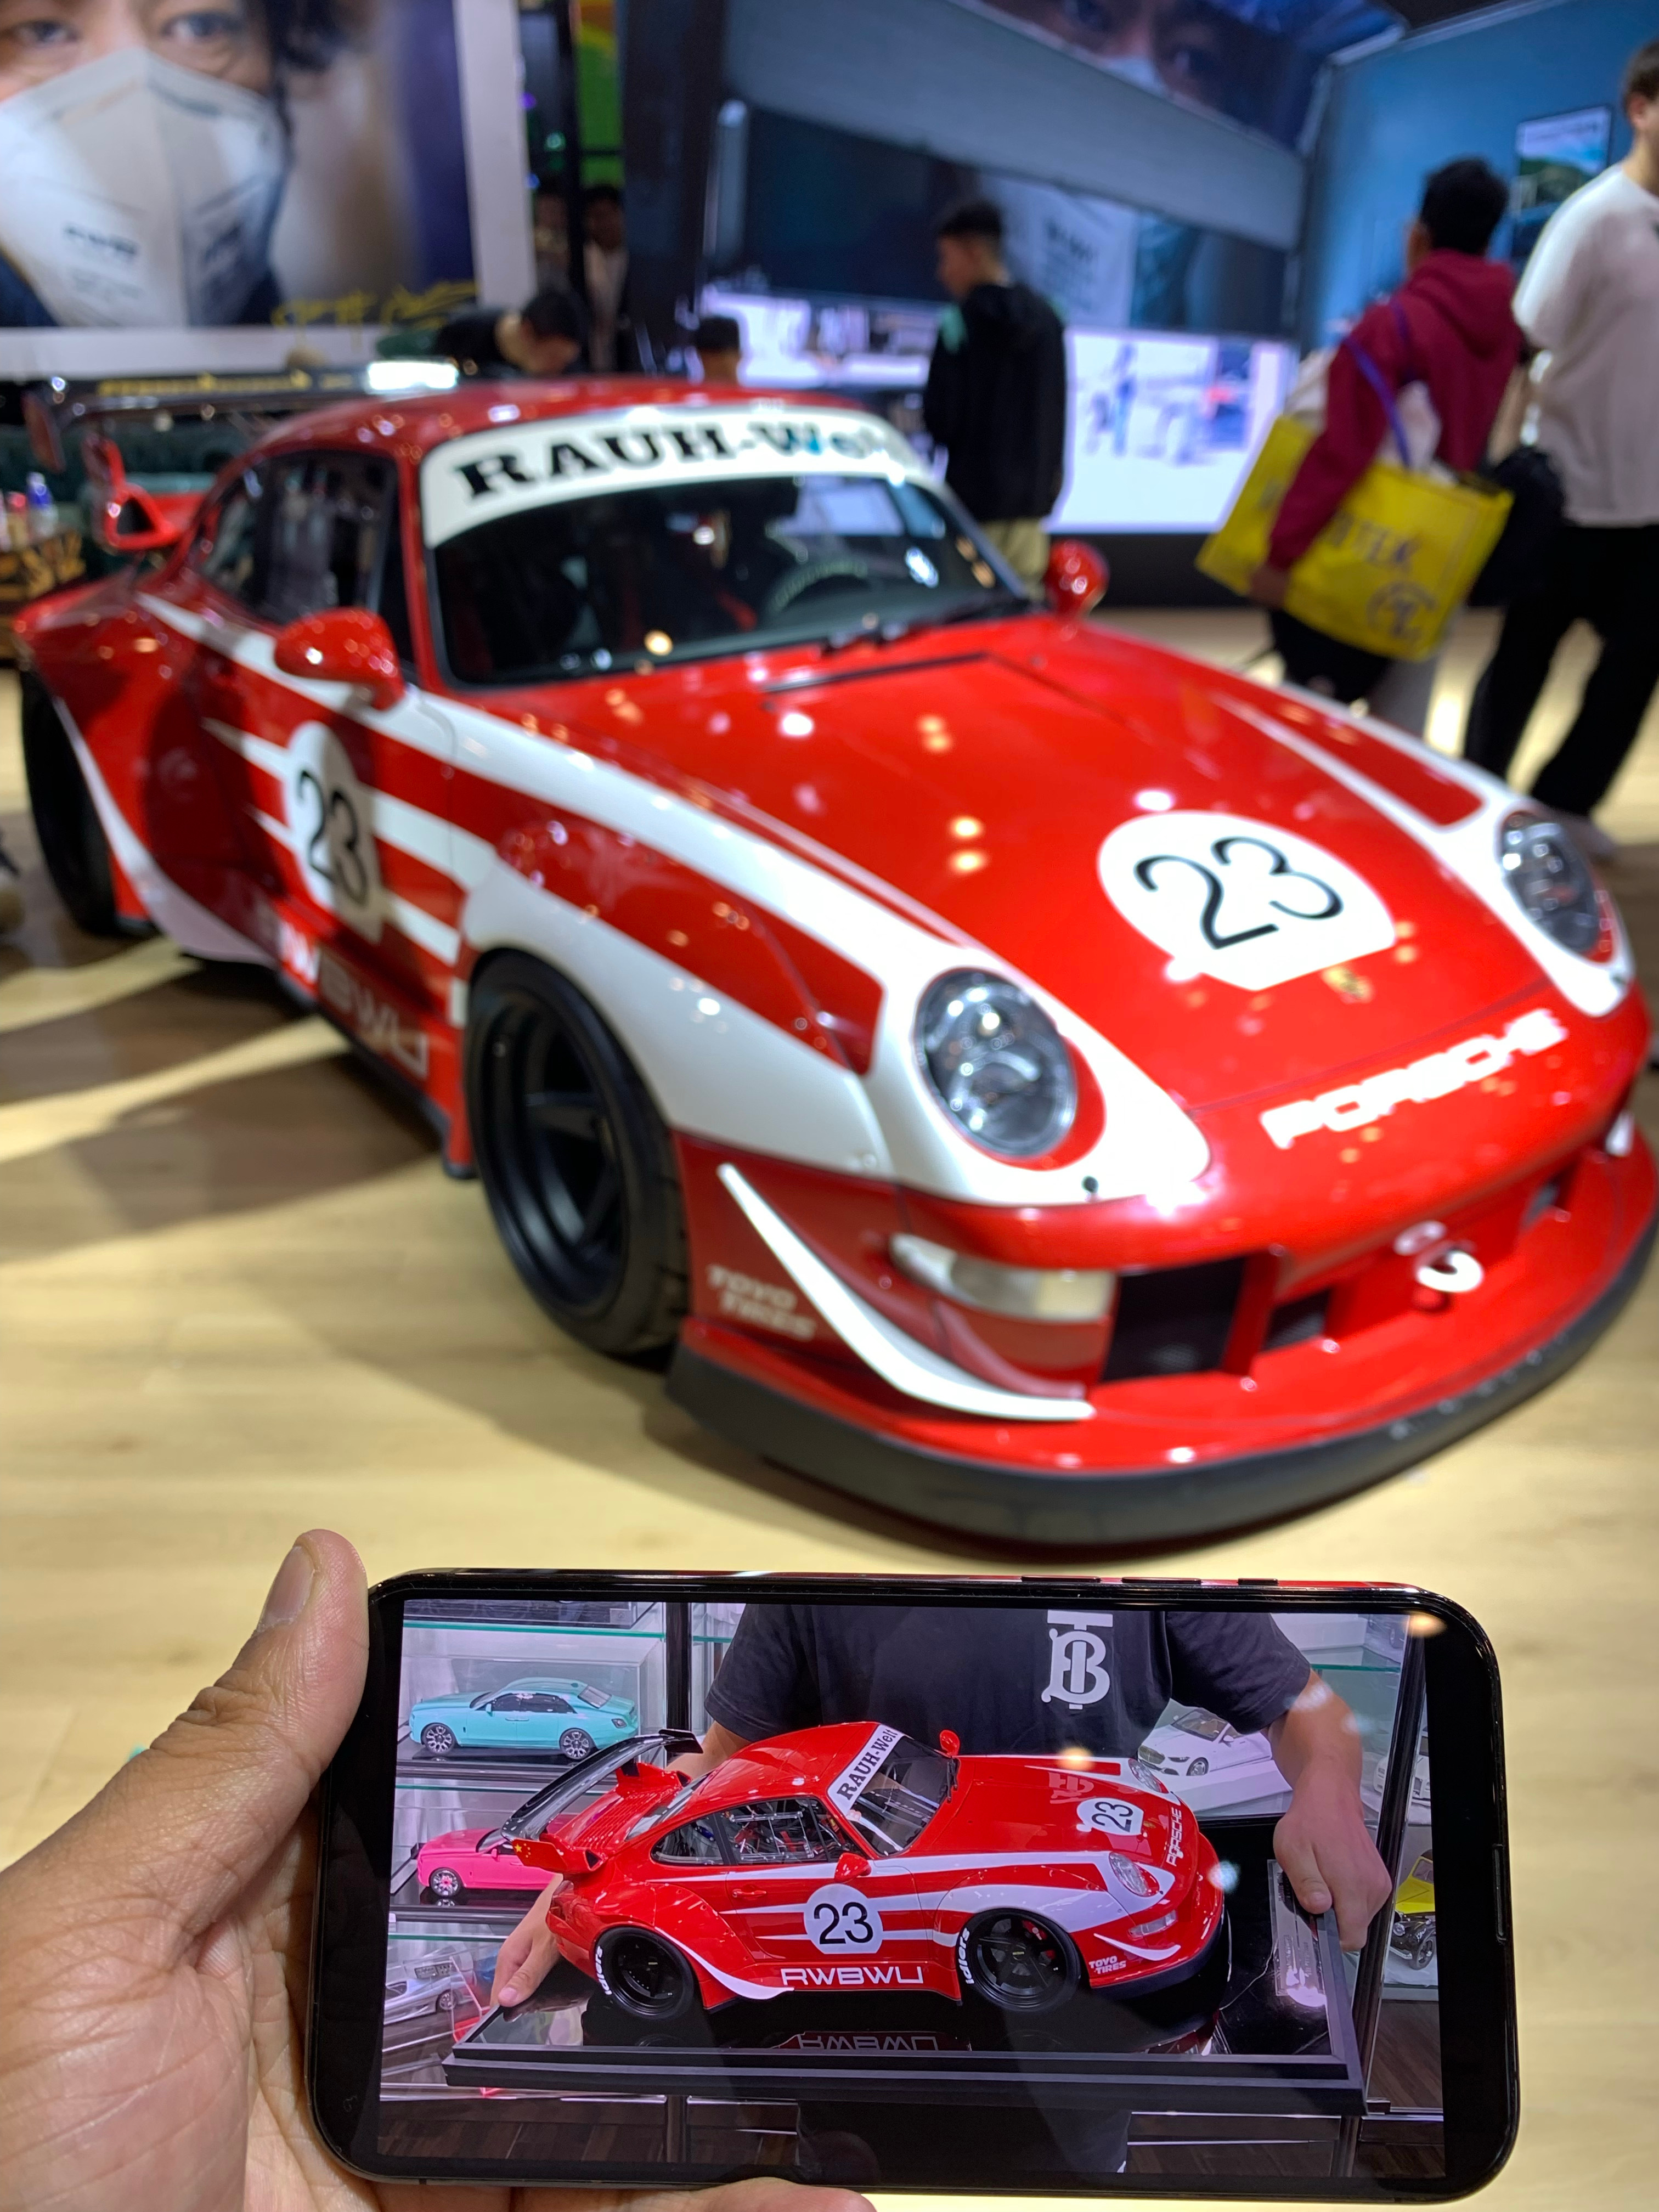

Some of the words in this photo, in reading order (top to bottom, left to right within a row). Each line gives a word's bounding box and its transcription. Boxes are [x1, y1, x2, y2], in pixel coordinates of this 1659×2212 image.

[296, 768, 369, 910] 23
[1133, 836, 1344, 950] 23
[837, 1729, 898, 1801] RAUH-Welt
[1092, 1802, 1133, 1832] 23
[1166, 1807, 1182, 1866] PORSCHE
[814, 1902, 873, 1944] 23
[781, 1966, 923, 1985] RWBWU
[1088, 1955, 1118, 1969] TOYO
[1096, 1960, 1126, 1974] TIRES
